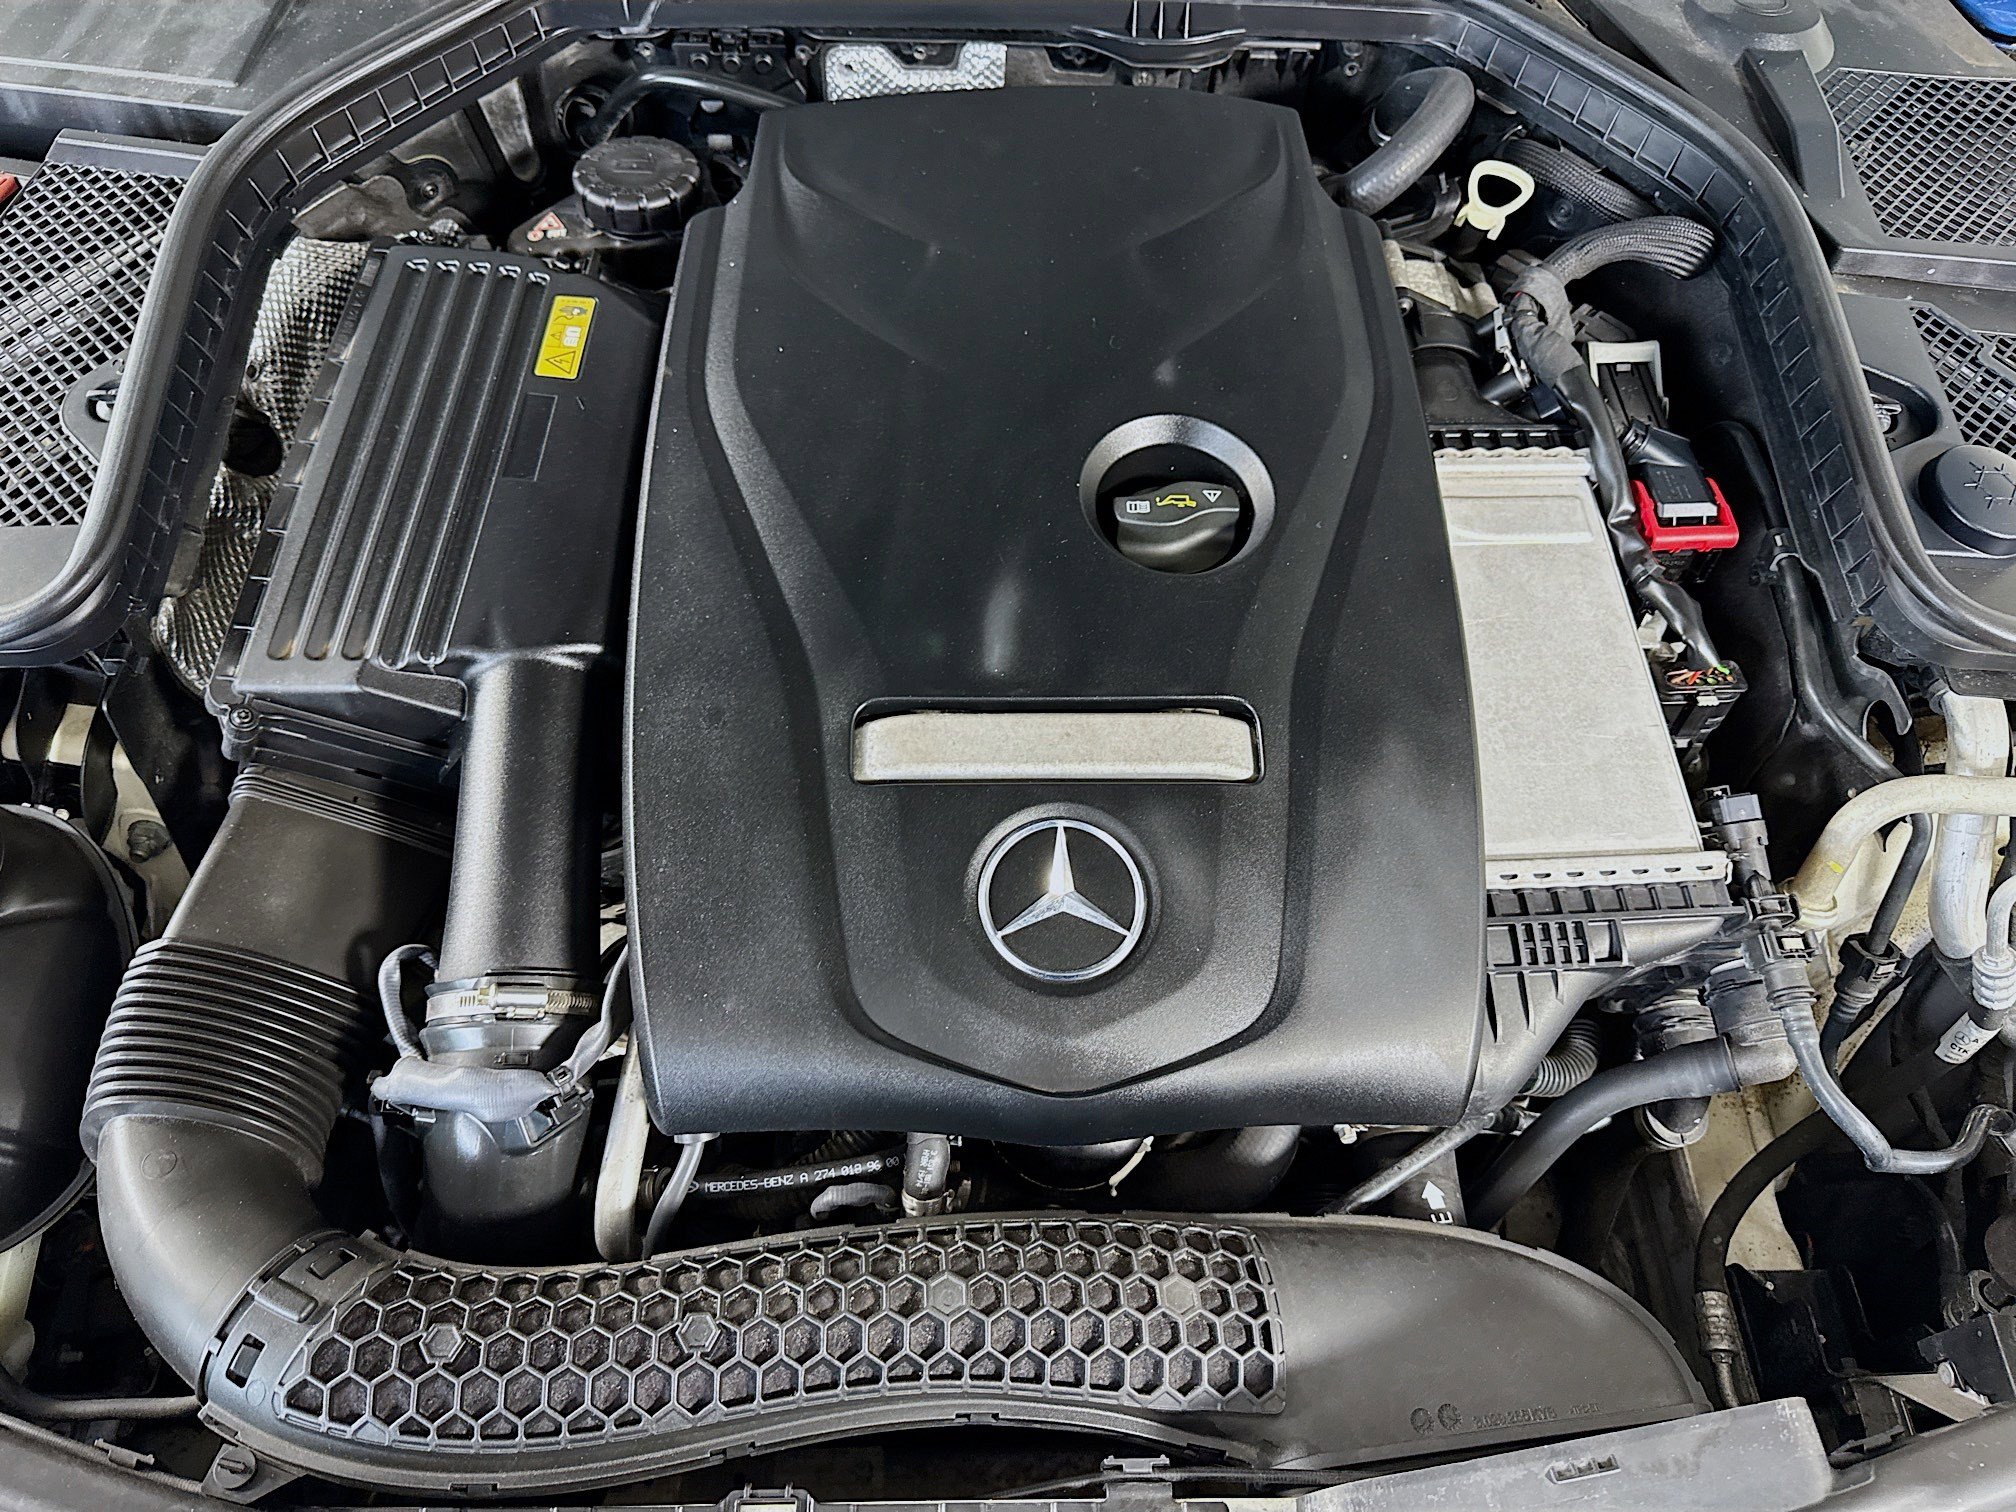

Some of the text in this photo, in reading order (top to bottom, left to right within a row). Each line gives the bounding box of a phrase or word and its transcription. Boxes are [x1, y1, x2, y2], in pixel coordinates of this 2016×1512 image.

[704, 1174, 794, 1193] MERCEDES-BENZ
[799, 1172, 809, 1184] A
[813, 1167, 836, 1182] 274
[840, 1163, 862, 1177] 018
[866, 1160, 881, 1173] 96
